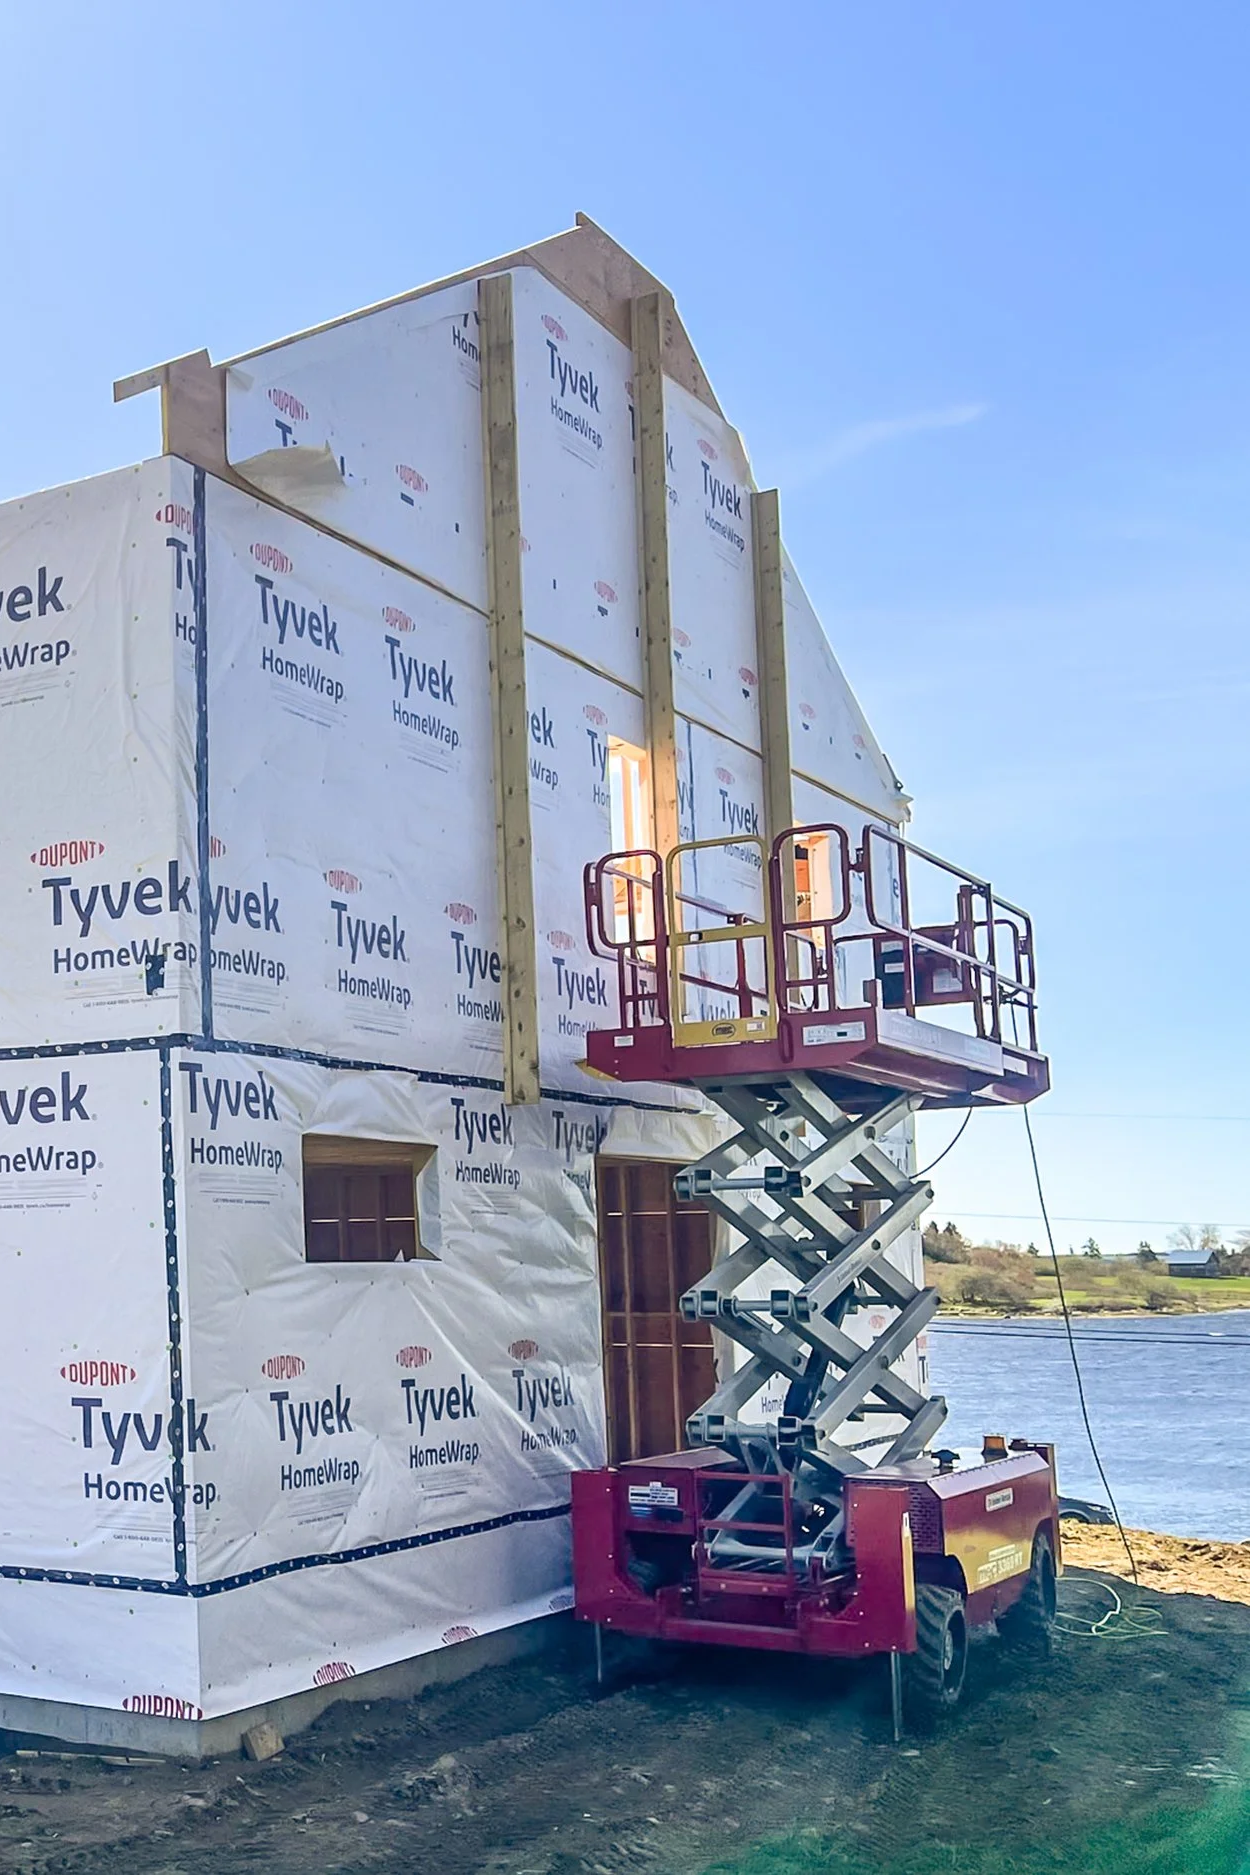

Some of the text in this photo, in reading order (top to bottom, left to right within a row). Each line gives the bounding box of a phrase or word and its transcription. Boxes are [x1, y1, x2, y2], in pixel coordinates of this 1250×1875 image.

[546, 339, 600, 413] Tyvek
[550, 396, 603, 450] HomeWrap
[701, 459, 741, 519] Tyvek
[704, 509, 745, 553] HomeWrap
[254, 574, 340, 654] Tyvek
[262, 646, 344, 704] HomeWrap
[385, 635, 455, 706] Tyvek
[392, 700, 459, 750] HomeWrap
[719, 789, 758, 836] Tyvek
[39, 840, 95, 867] DUPONT
[42, 859, 192, 938] Tyvek
[209, 882, 281, 935] yvek
[331, 900, 406, 964] Tyvek
[210, 949, 286, 985] omeWrap
[451, 931, 500, 988] Tyve
[552, 957, 608, 1010] Tyvek
[338, 969, 411, 1010] HomeWrap
[179, 1062, 278, 1130] Tyvek
[451, 1098, 513, 1153] Tyvek
[191, 1137, 283, 1173] HomeWrap
[455, 1160, 520, 1190] HomeWrap
[69, 1361, 128, 1386] DUPONT
[267, 1355, 301, 1380] DUPONT
[270, 1384, 353, 1455] Tyvek
[401, 1374, 475, 1436] Tyvek
[512, 1370, 575, 1422] Tyvek
[71, 1397, 211, 1465] Tyvk
[410, 1439, 479, 1469] HomeWrap
[281, 1457, 360, 1491] HomeWrap
